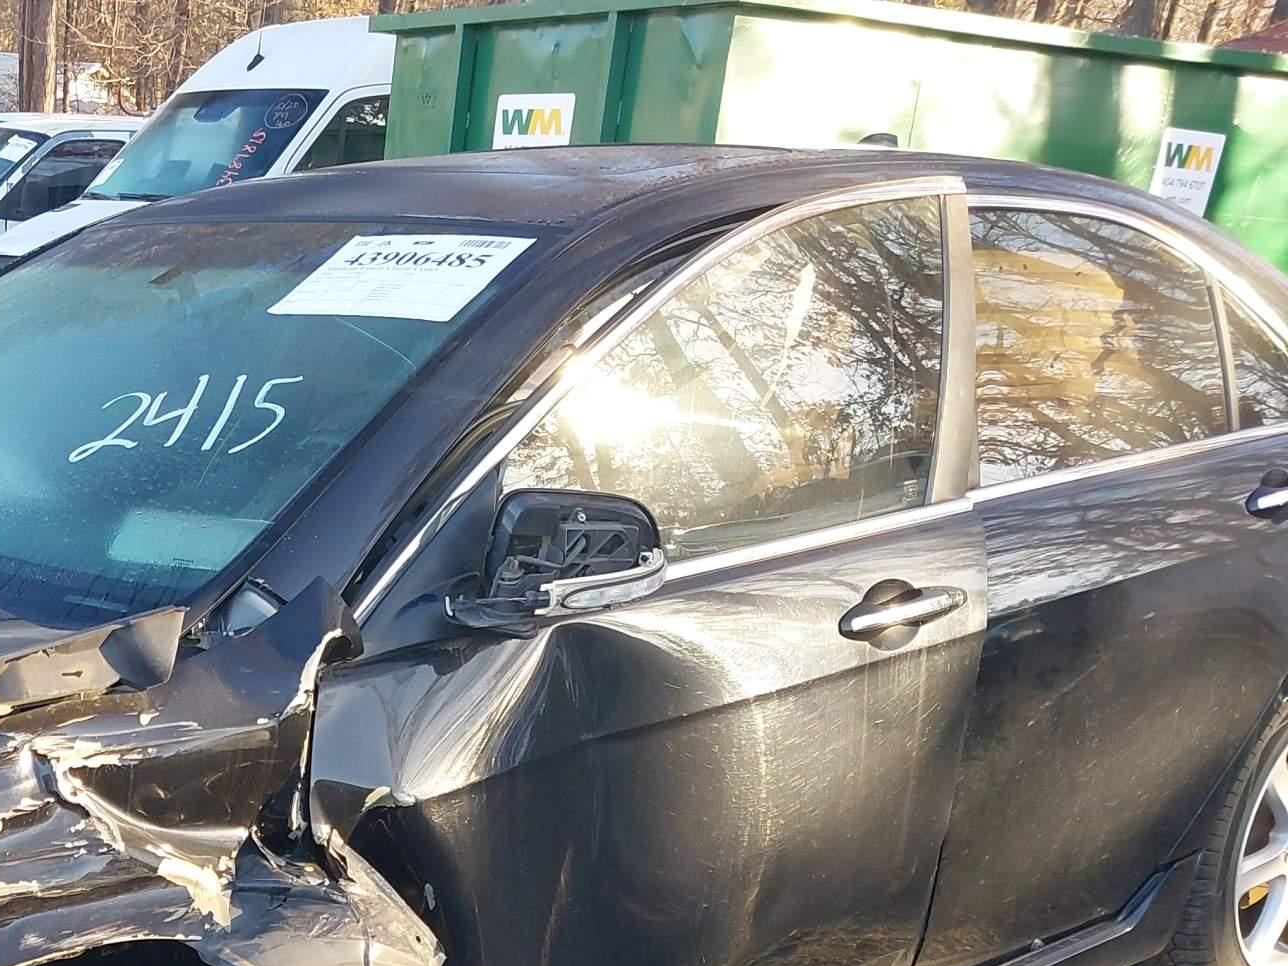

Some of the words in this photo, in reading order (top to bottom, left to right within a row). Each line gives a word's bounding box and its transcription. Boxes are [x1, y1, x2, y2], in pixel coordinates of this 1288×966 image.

[502, 108, 562, 136] WM
[1164, 142, 1214, 173] WM
[344, 250, 495, 269] 43906485
[68, 374, 304, 463] 2415
